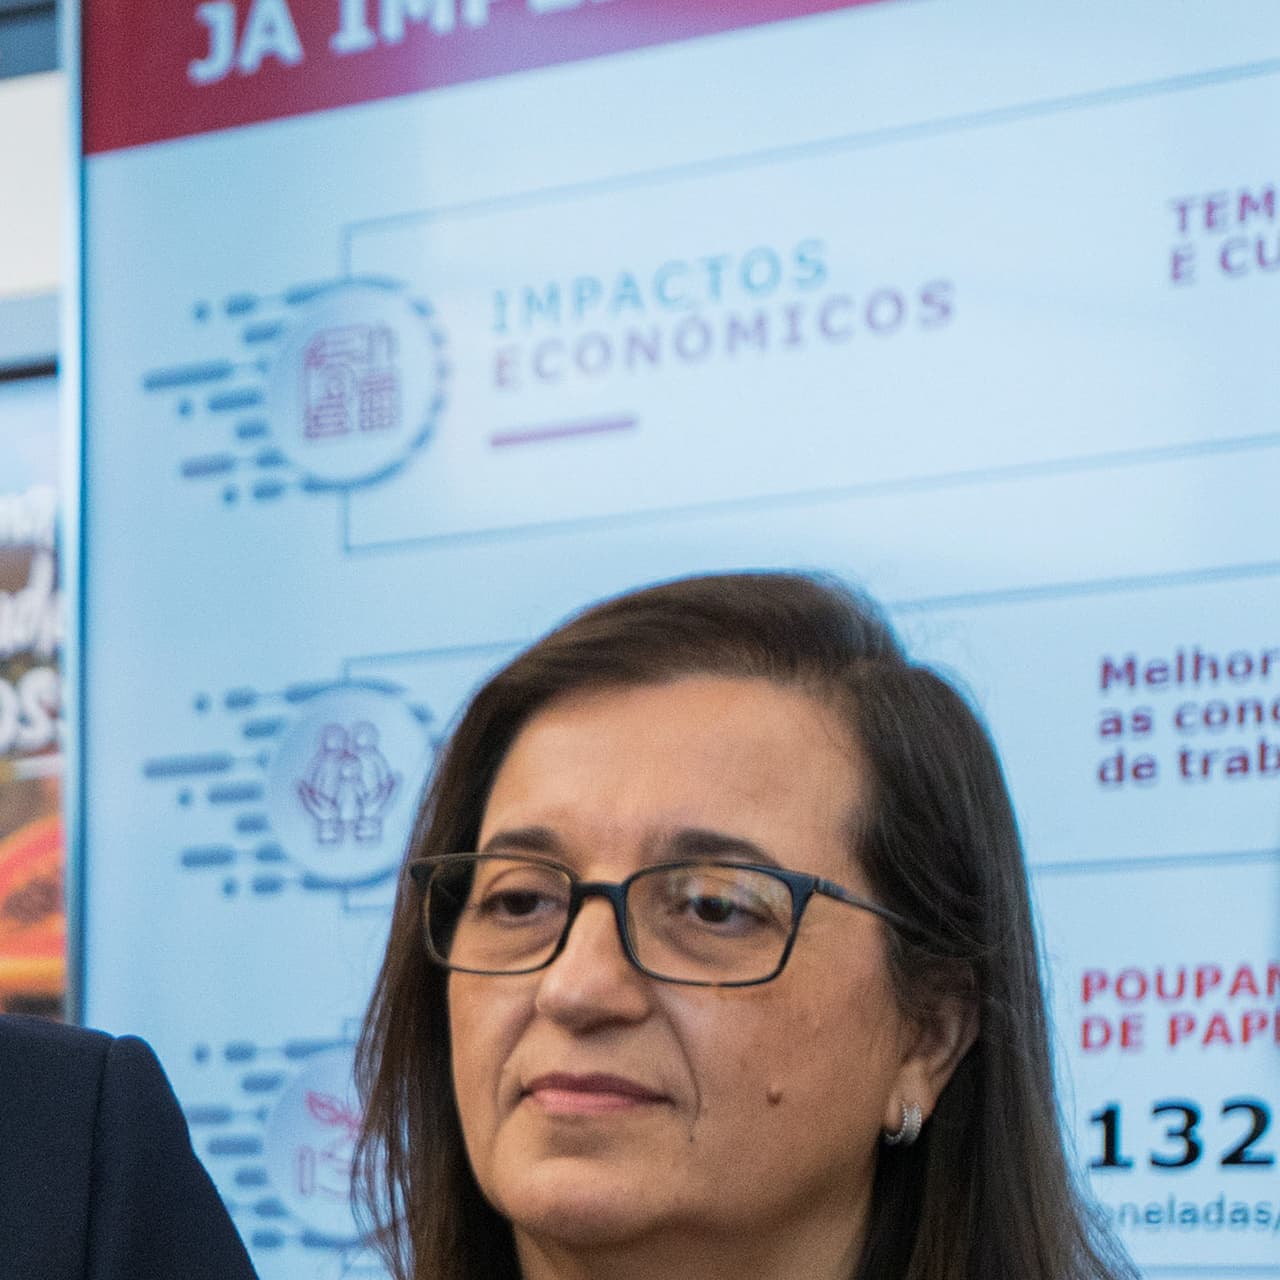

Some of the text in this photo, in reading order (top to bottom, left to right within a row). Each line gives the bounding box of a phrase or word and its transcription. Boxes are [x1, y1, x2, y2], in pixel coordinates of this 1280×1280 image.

[492, 238, 830, 334] IMPACTOS
[1098, 707, 1153, 742] as
[1097, 749, 1157, 789] de
[1080, 1014, 1144, 1053] DE
[1089, 1098, 1276, 1170] 132
